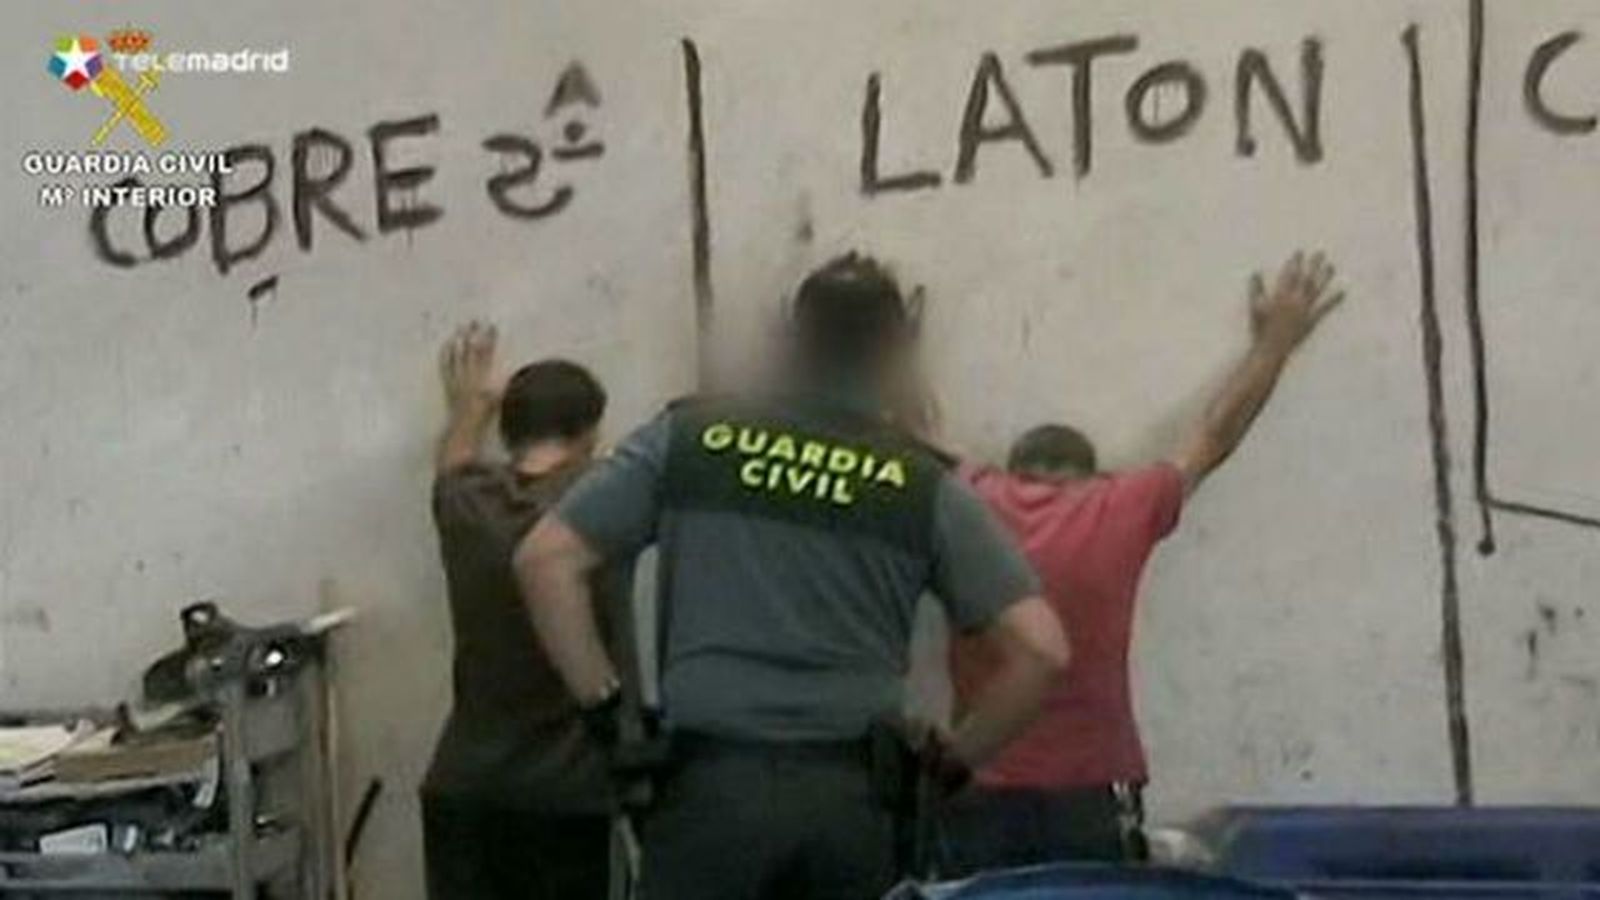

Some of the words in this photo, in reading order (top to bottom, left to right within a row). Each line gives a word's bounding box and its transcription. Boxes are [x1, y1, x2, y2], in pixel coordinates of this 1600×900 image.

[860, 34, 1324, 196] LATON
[90, 113, 443, 275] COBRE
[702, 423, 905, 488] GUARDIA
[740, 459, 855, 504] CIVIL
